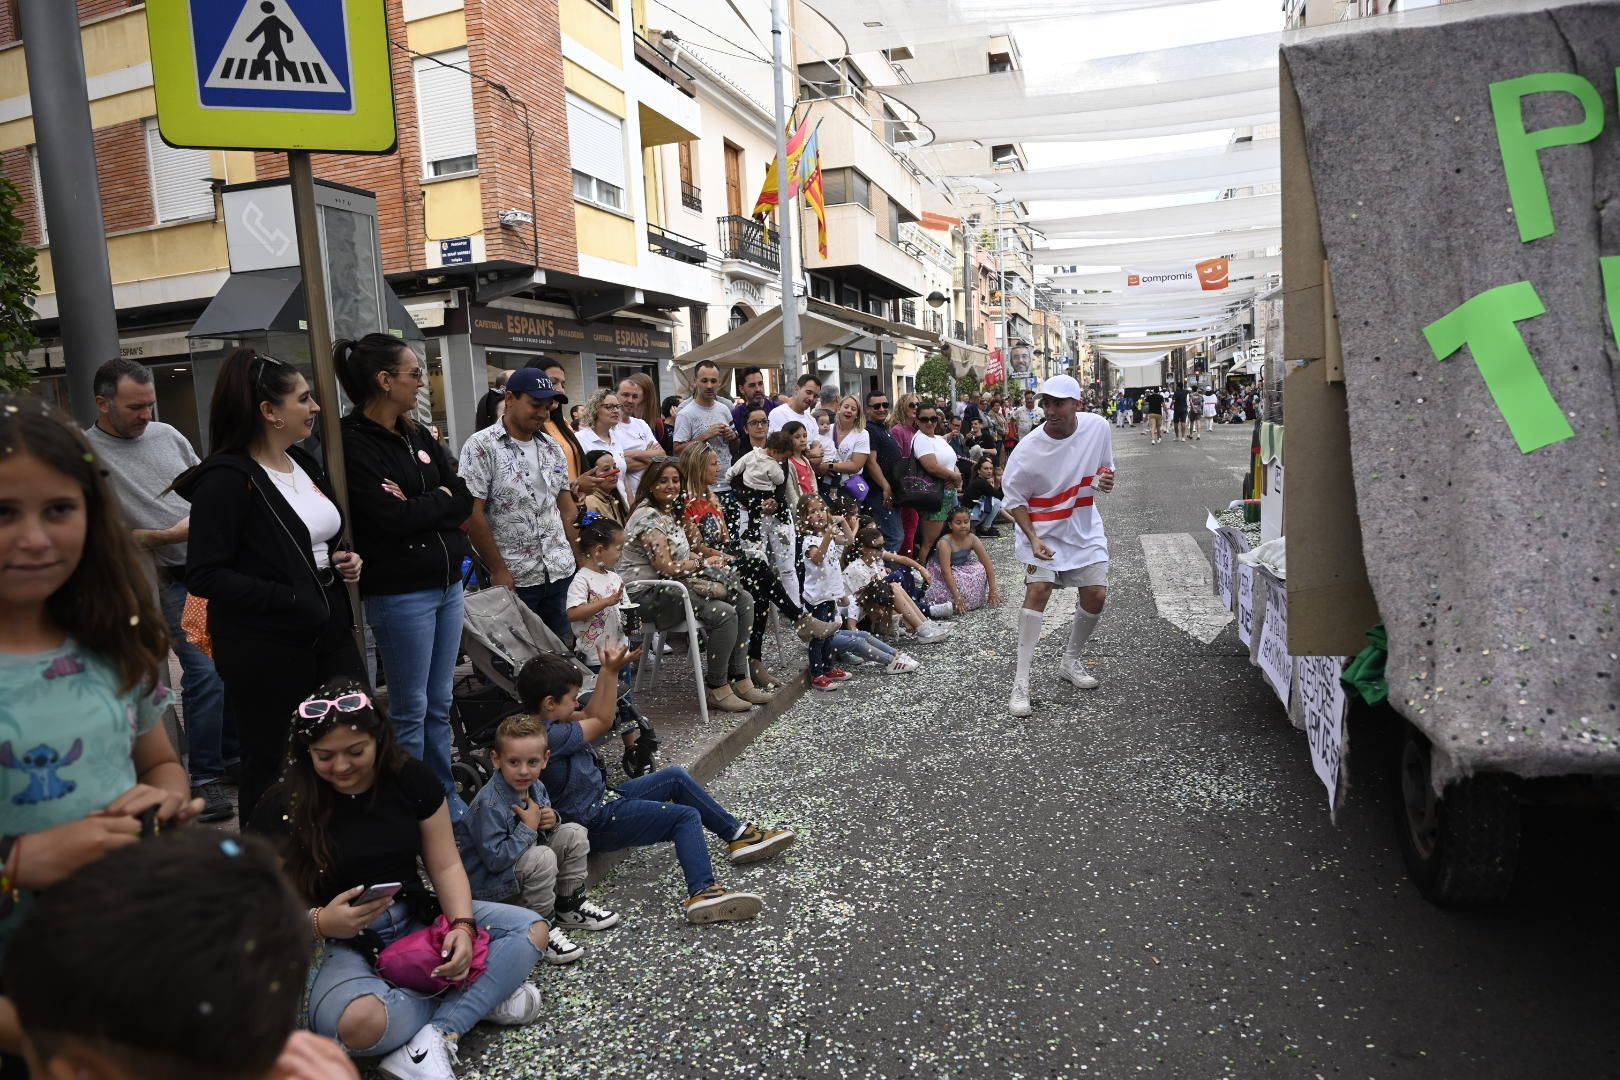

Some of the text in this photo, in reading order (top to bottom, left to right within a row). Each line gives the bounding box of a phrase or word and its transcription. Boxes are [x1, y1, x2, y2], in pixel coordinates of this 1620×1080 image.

[1489, 66, 1620, 243] P
[506, 315, 555, 337] ESPAN'S
[615, 329, 649, 348] ESPAN'S
